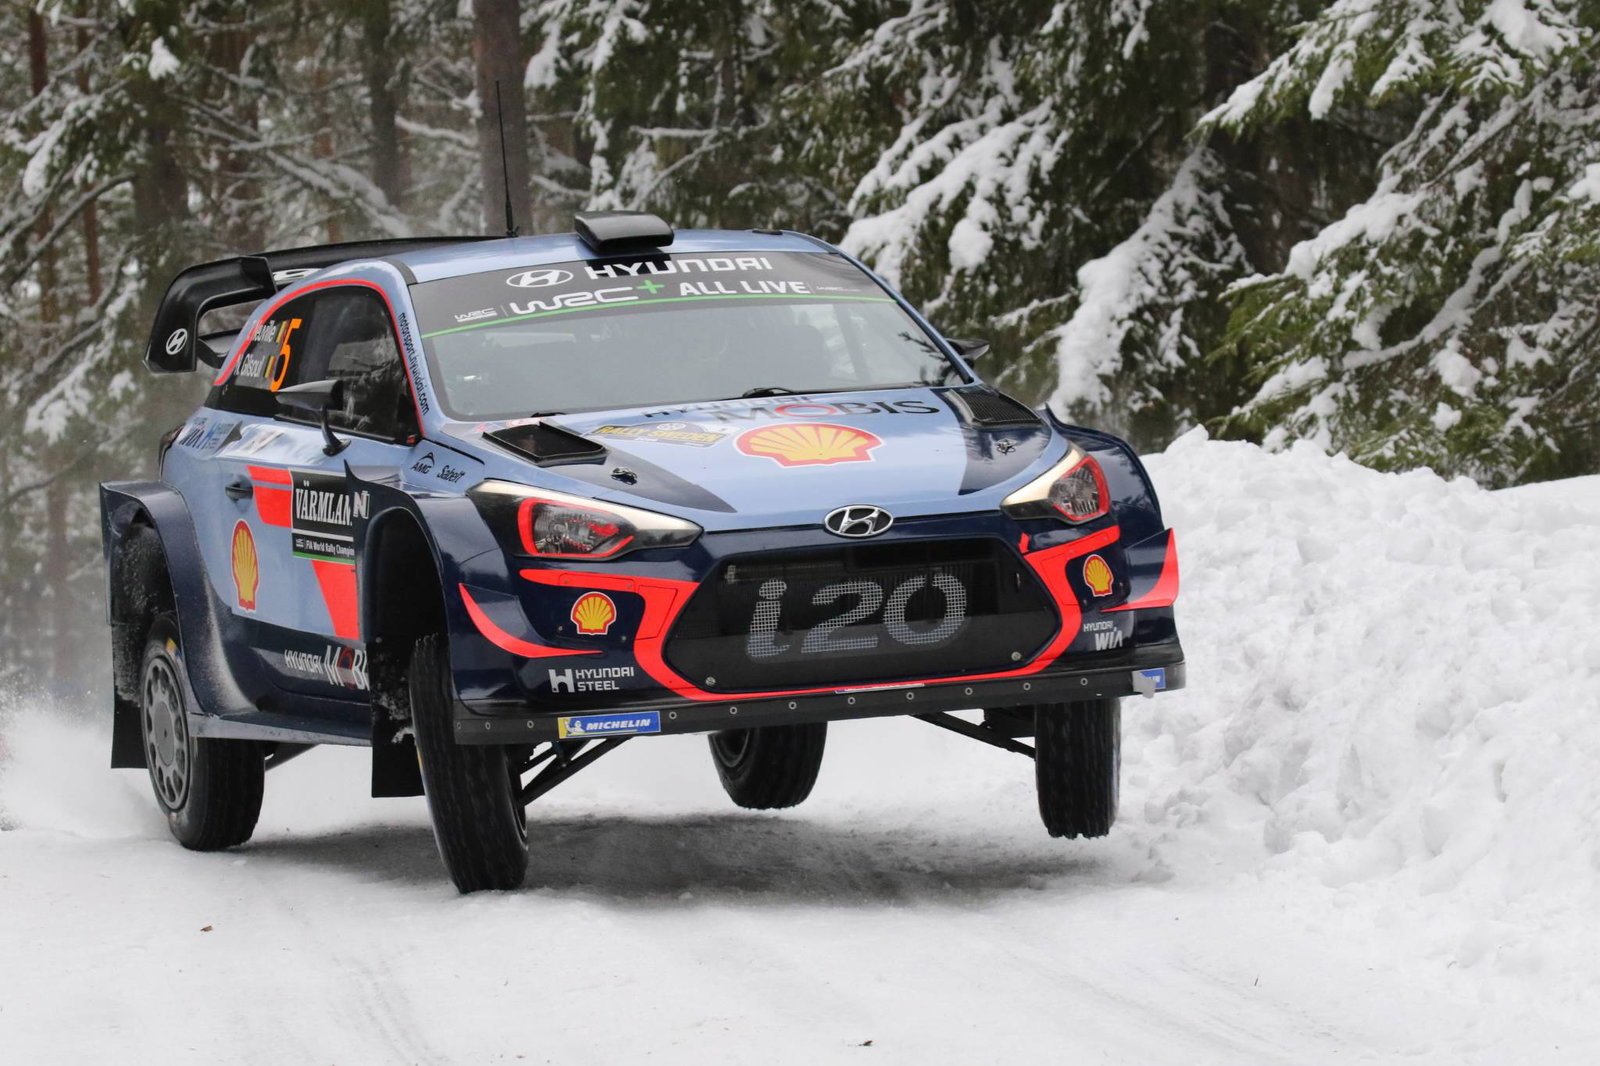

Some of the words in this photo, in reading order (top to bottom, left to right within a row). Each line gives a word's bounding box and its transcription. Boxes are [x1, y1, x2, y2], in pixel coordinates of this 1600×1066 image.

[584, 257, 773, 280] HYUNDAI
[680, 281, 737, 297] ALL
[743, 280, 811, 295] LIVE
[270, 318, 303, 392] 5
[708, 400, 940, 424] MOBIS
[295, 479, 353, 527] VÄRMLAN
[313, 541, 326, 552] World
[325, 543, 336, 556] Rally
[747, 573, 968, 658] i20
[1083, 620, 1114, 632] HYUNDAI
[284, 649, 324, 675] HYUNDAI
[324, 645, 370, 692] MOBI
[575, 666, 635, 680] HYUNDAI
[577, 680, 620, 692] STEEL
[586, 718, 651, 731] MICHELIN
